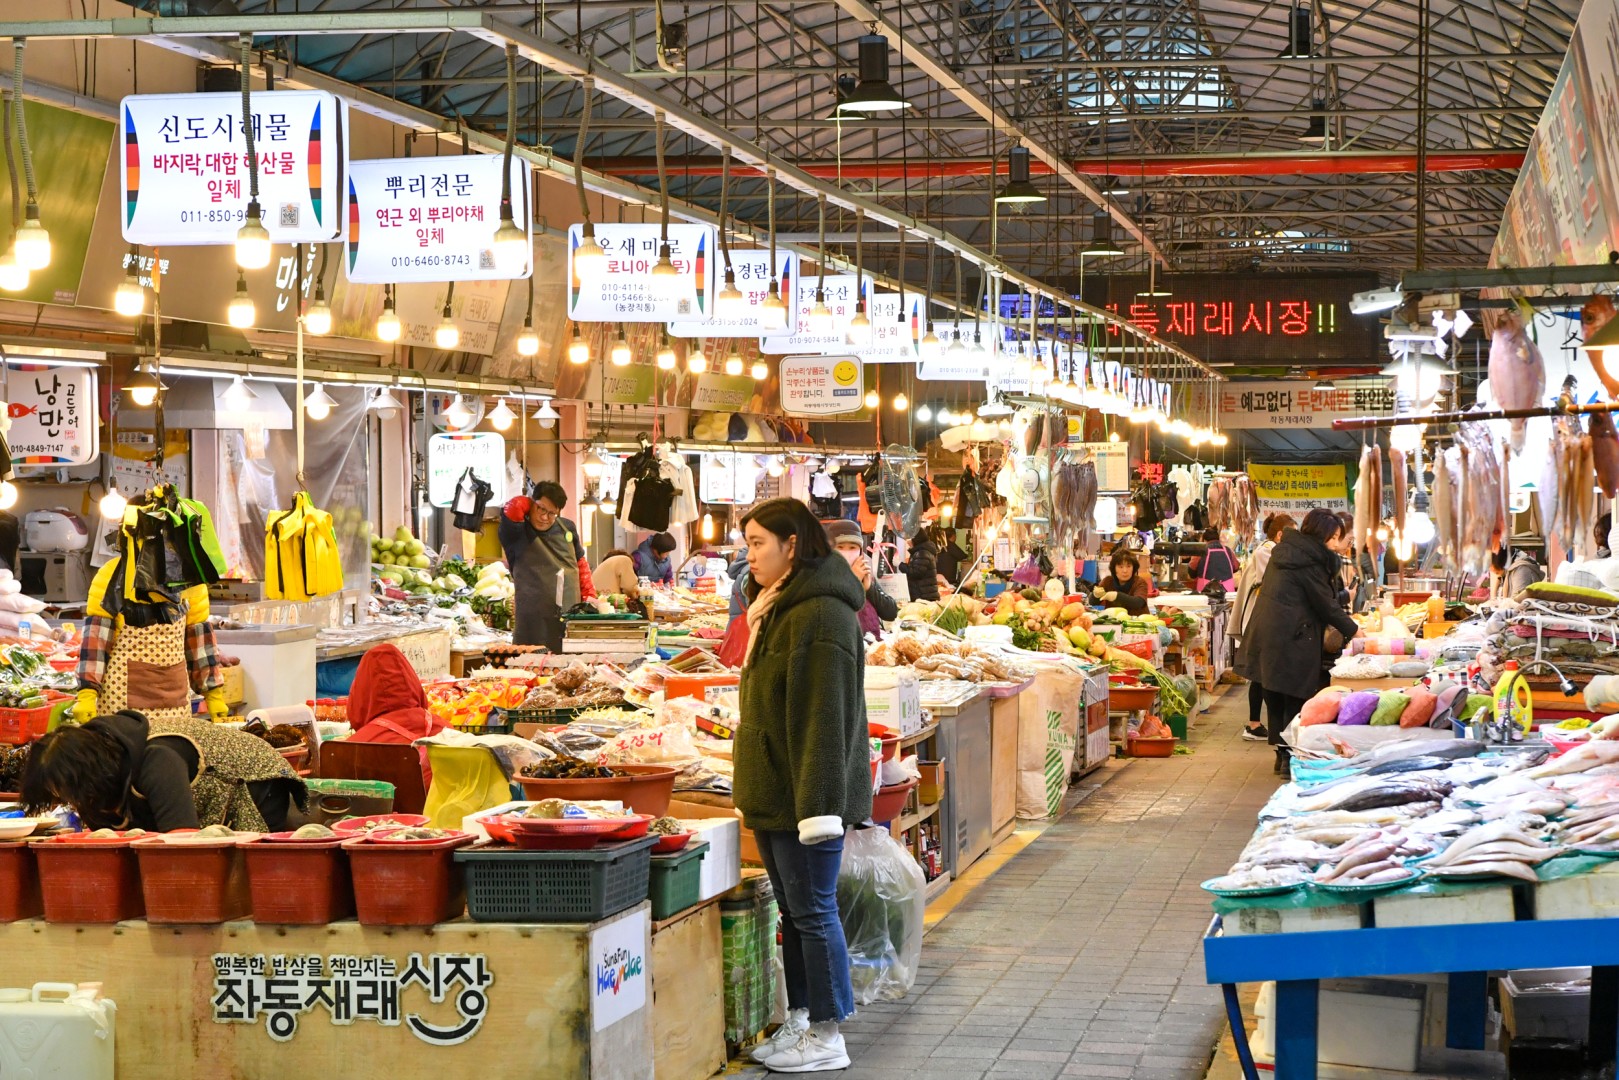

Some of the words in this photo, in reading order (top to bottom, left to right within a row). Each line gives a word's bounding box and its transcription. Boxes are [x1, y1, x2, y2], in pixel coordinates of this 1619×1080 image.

[158, 113, 291, 144] 신도시해물
[207, 179, 241, 203] 일체
[384, 173, 474, 200] 뿌리전문
[180, 209, 267, 223] 011-850-97
[376, 208, 404, 228] 연근
[408, 207, 422, 224] 외
[427, 205, 484, 224] 뿌리야채
[416, 228, 444, 247] 일체
[391, 254, 470, 267] 010-6460-8743
[607, 260, 649, 275] 로니아
[34, 373, 64, 438] 낭만
[66, 383, 79, 428] 고등어
[1240, 390, 1293, 413] 예고없다
[1296, 389, 1349, 413] 두번세번
[1354, 388, 1396, 412] 확인점
[10, 444, 64, 453] 010-4849-7147
[214, 957, 265, 977] 행복한
[271, 957, 323, 978] 밥상을
[329, 957, 396, 978] 책임지는
[597, 950, 642, 996] Haeundae
